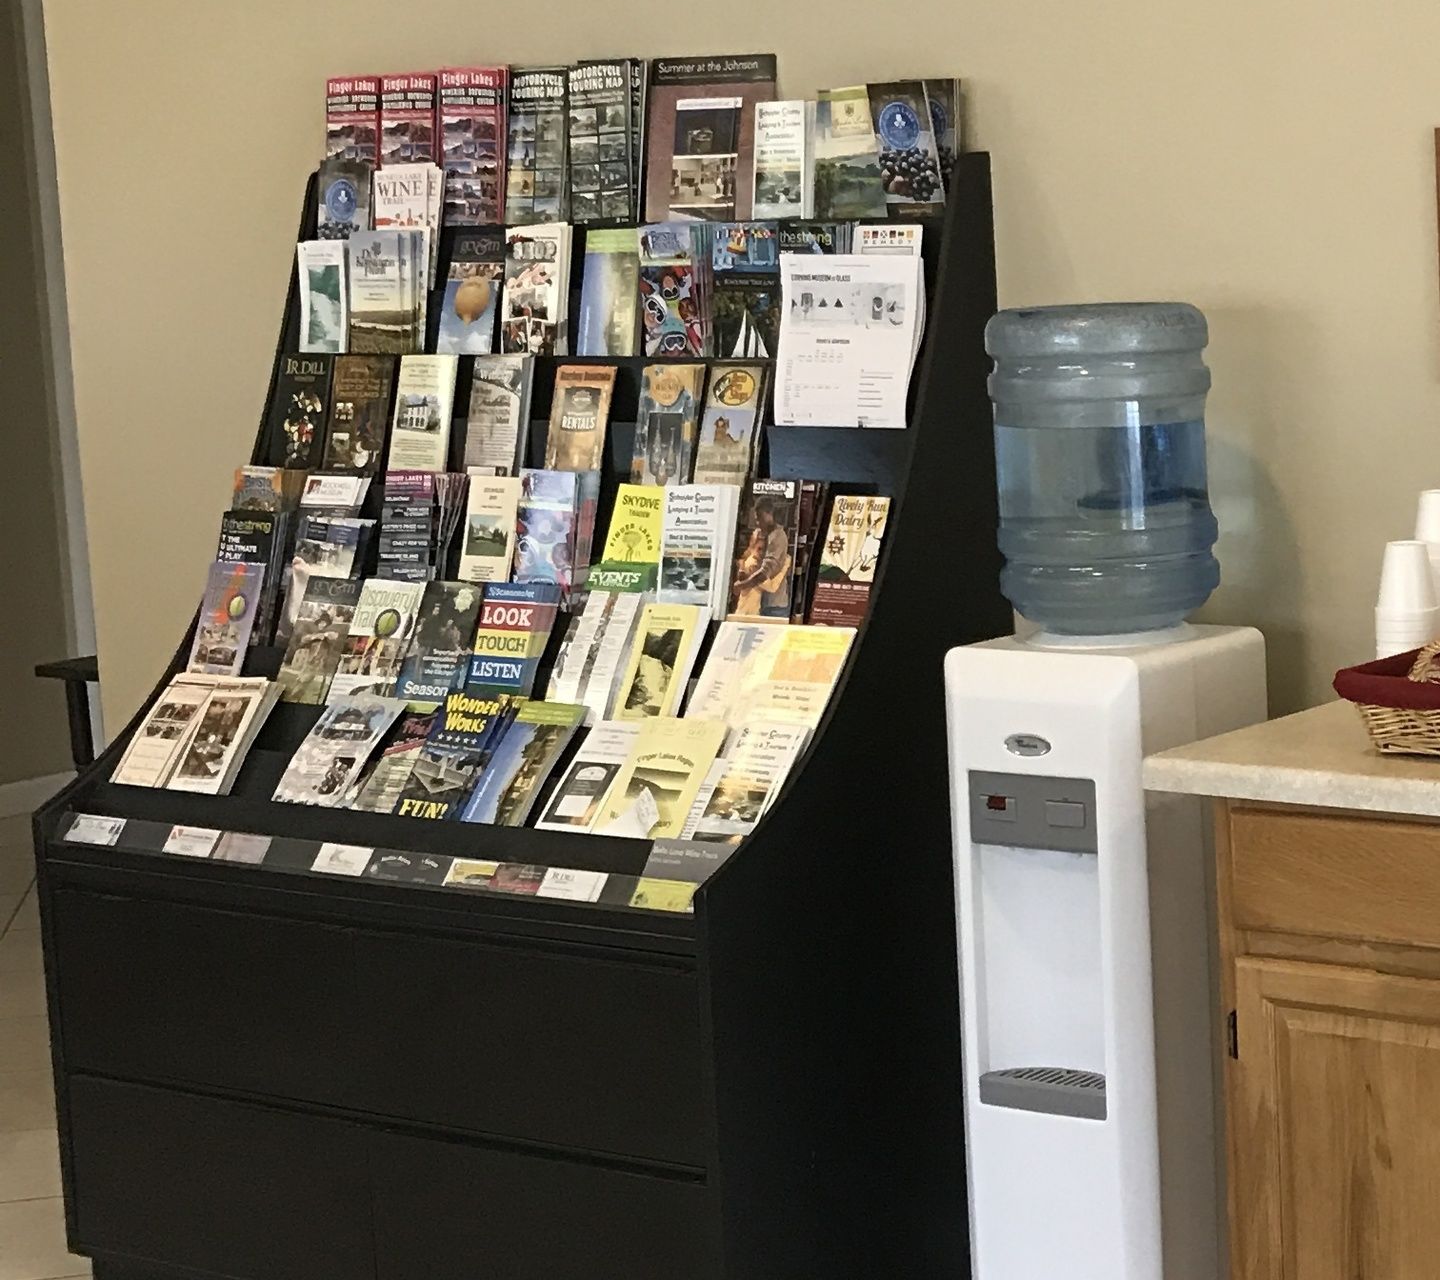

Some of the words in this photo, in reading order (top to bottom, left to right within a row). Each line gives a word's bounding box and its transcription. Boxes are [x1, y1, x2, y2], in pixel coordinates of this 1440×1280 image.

[569, 65, 621, 80] MOTORCYCLE
[658, 62, 695, 74] Summer
[696, 63, 705, 73] at
[707, 61, 722, 72] the
[722, 60, 758, 72] Johnson
[328, 82, 352, 94] Finger
[354, 80, 376, 93] Lakes
[384, 77, 408, 91] Finger
[410, 75, 432, 90] Lakes
[442, 72, 469, 87] Finger
[471, 71, 494, 87] Lakes
[513, 73, 563, 89] MOTORCYCLE
[568, 78, 603, 93] TOURING
[605, 77, 624, 90] MAP
[511, 86, 545, 99] TOURING
[546, 86, 565, 98] MAP
[377, 180, 423, 197] WINE
[301, 360, 326, 375] DILL
[562, 415, 596, 430] RENTALS
[753, 482, 786, 491] KITCHEN
[622, 494, 661, 510] SKYDIVE
[695, 492, 715, 503] County
[837, 498, 865, 513] Lively
[866, 499, 887, 512] Run
[834, 513, 865, 530] Dairy
[228, 535, 240, 543] THE
[224, 552, 242, 560] PLAY
[226, 544, 257, 553] ULTIMATE
[588, 571, 642, 583] EVENTS
[481, 606, 534, 626] LOOK
[478, 634, 528, 653] TOUCH
[471, 660, 523, 679] LISTEN
[403, 680, 449, 697] Season
[446, 692, 500, 716] WONDER
[445, 712, 488, 734] WORKS
[398, 799, 449, 820] FUN!
